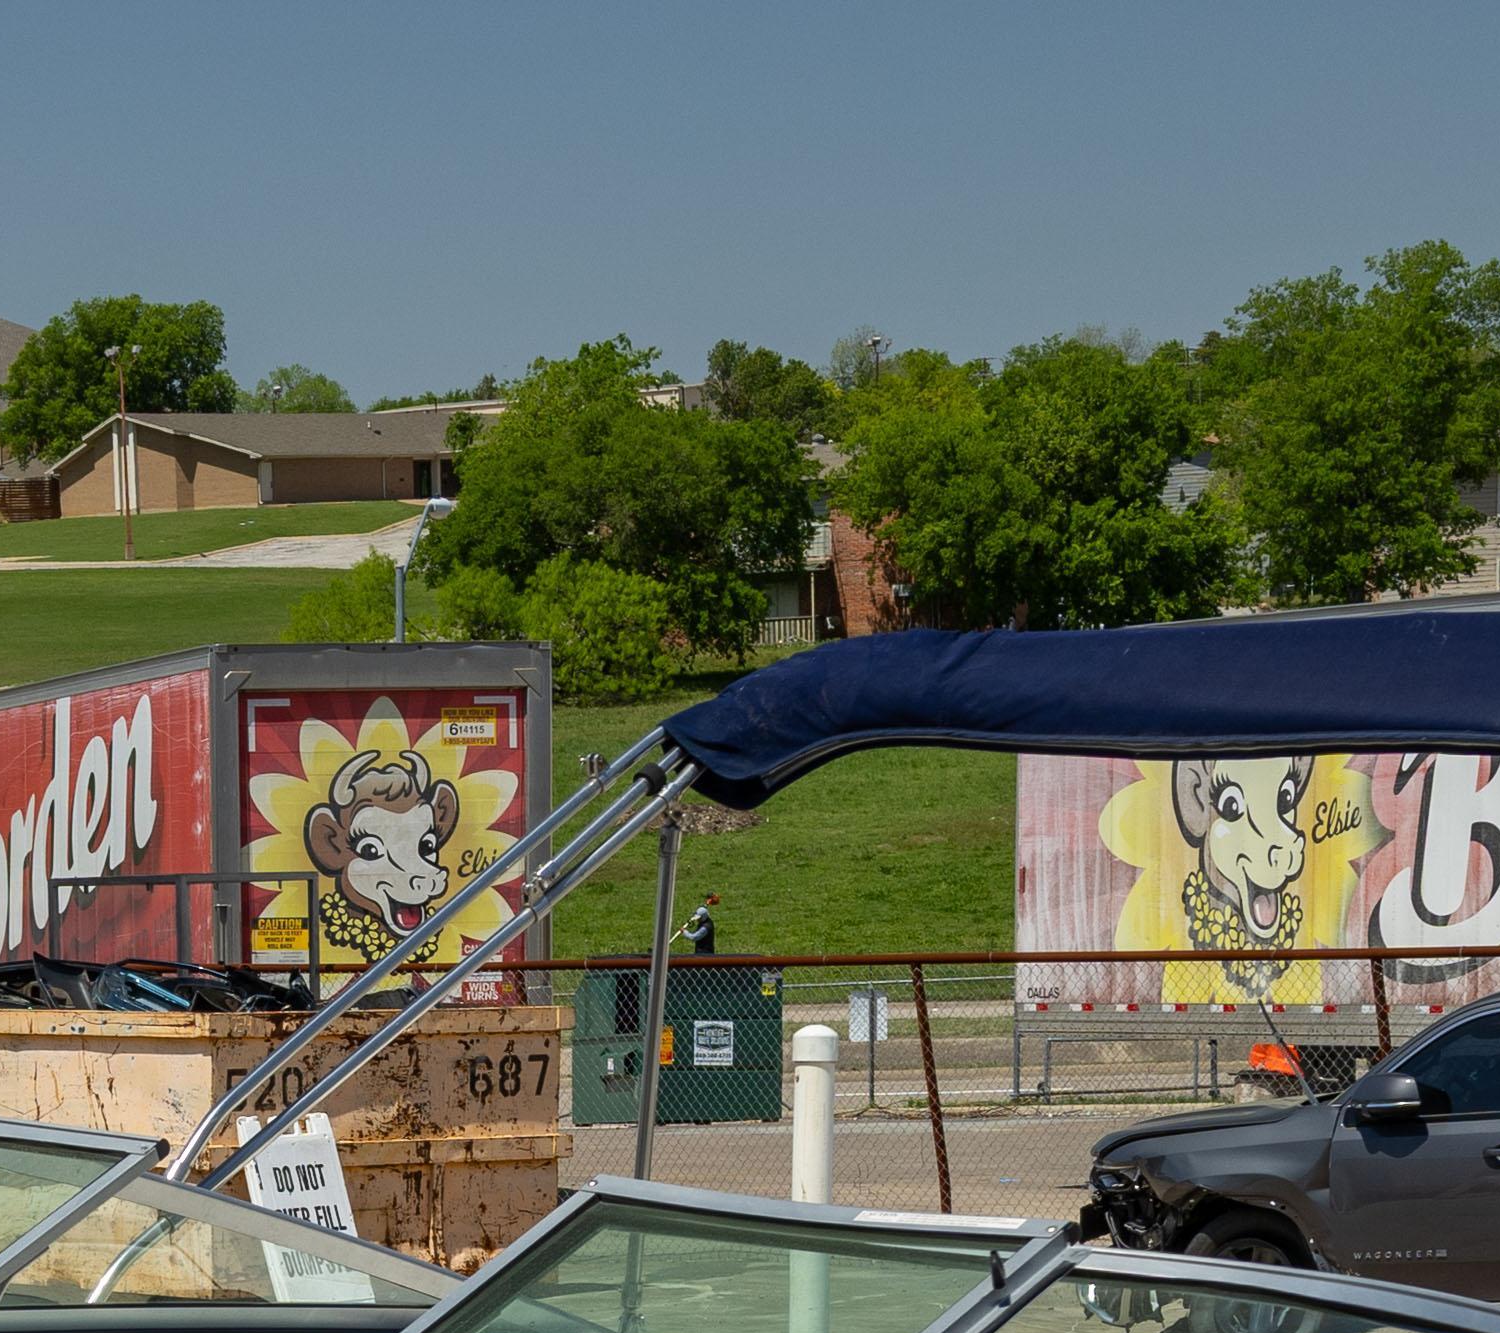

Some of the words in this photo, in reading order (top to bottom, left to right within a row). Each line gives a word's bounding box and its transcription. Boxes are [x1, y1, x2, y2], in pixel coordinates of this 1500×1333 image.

[1312, 797, 1362, 844] Elsie
[457, 847, 496, 878] Elsi
[258, 919, 302, 929] CAUTION
[466, 991, 499, 1000] TURNS
[469, 982, 496, 991] WIDE
[1027, 986, 1060, 999] DALLAS
[469, 1054, 550, 1097] 687
[273, 1166, 295, 1193] DO
[297, 1163, 327, 1192] NOT
[313, 1204, 348, 1231] FILL
[1353, 1249, 1433, 1259] WAGONEER
